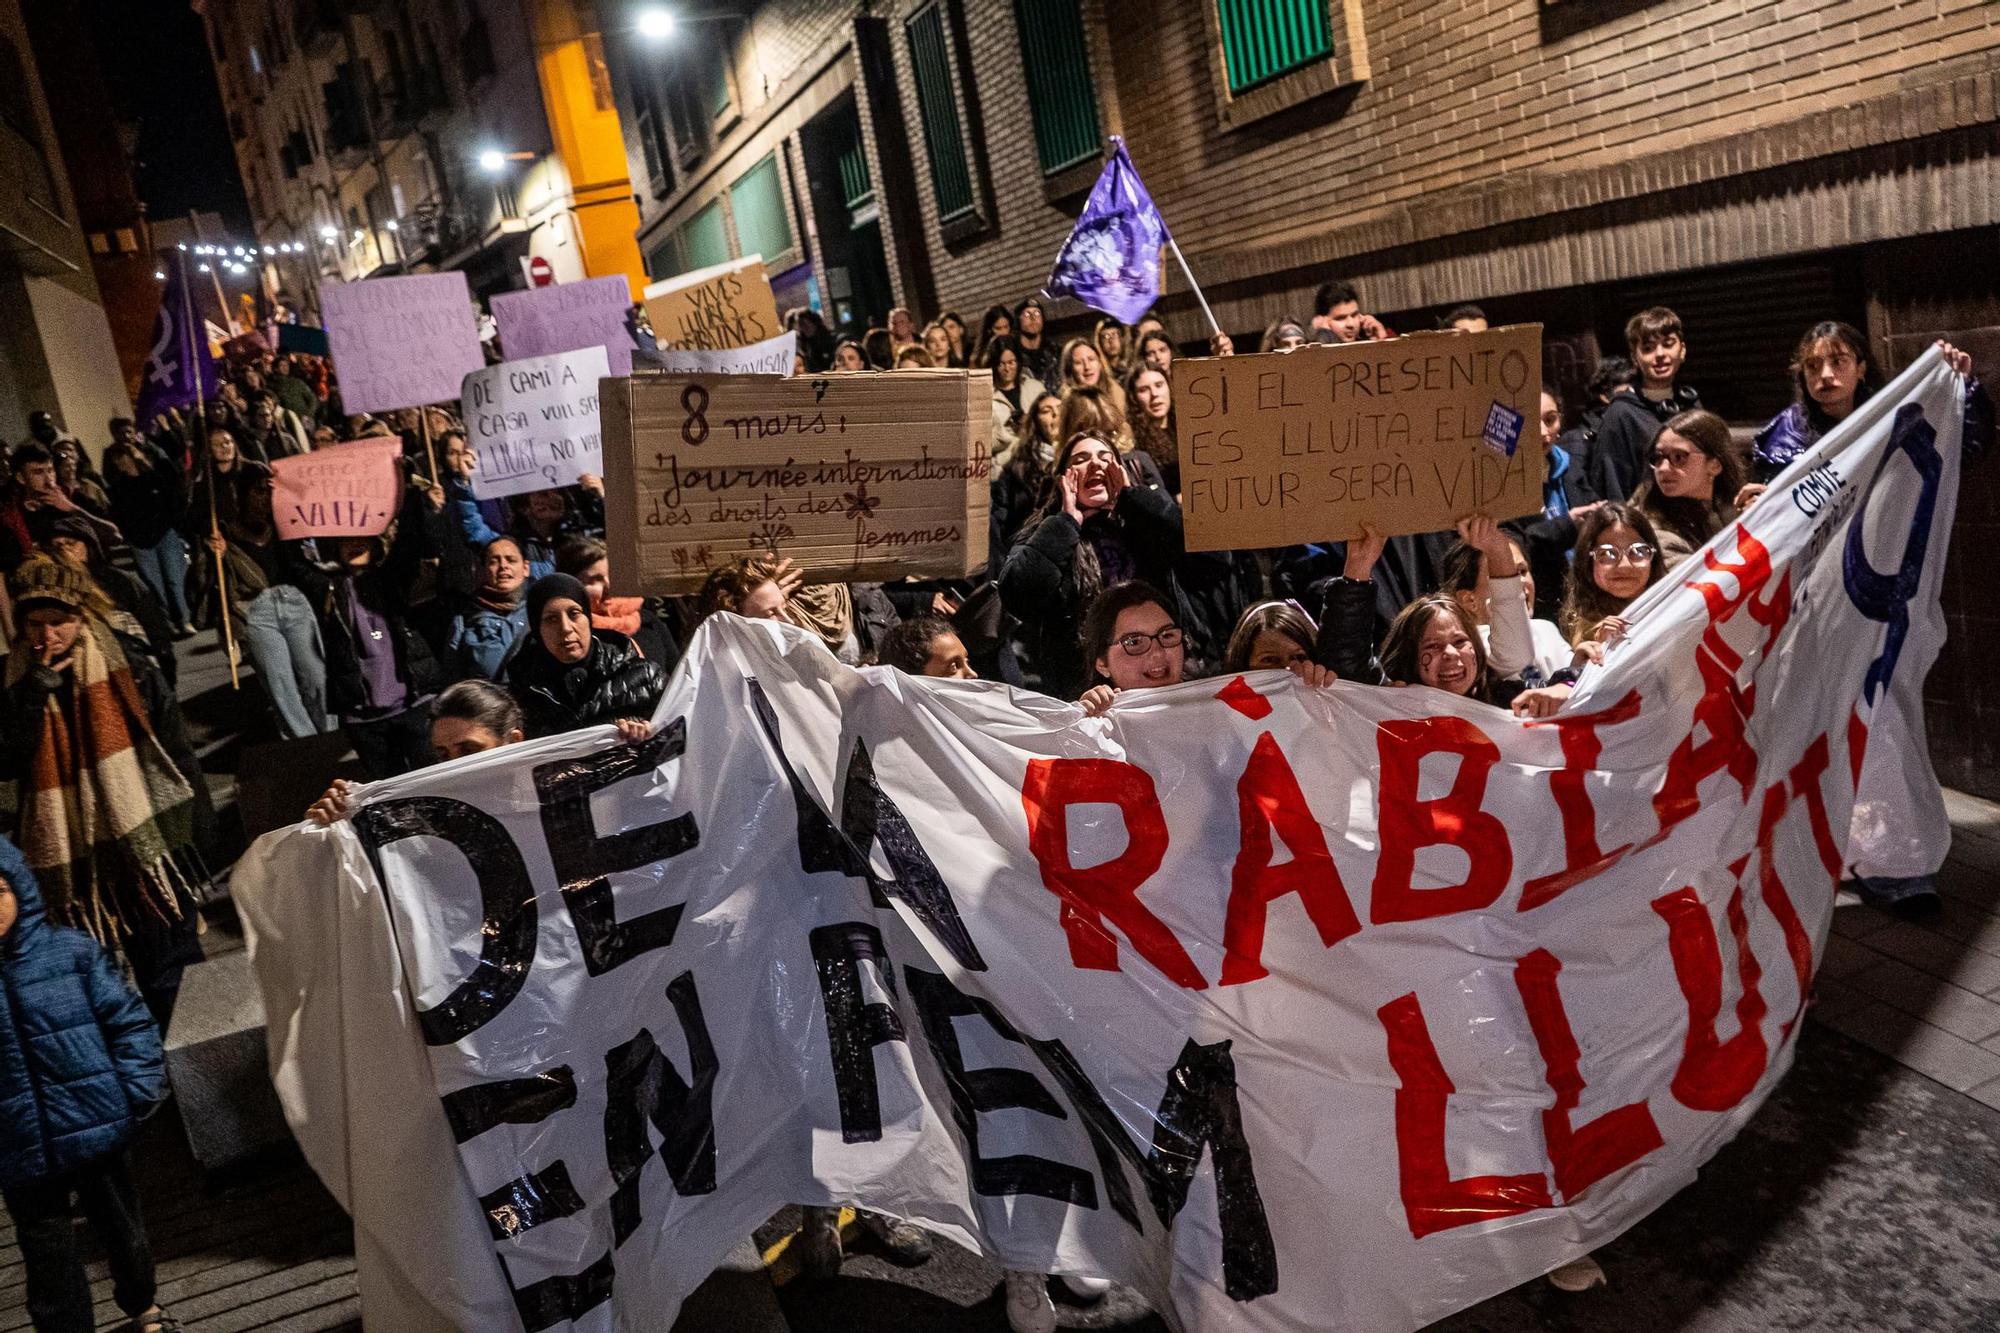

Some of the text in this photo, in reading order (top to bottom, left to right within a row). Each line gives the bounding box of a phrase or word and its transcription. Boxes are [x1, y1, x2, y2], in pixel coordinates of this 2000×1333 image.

[473, 379, 494, 408] DE
[562, 365, 577, 385] A
[681, 384, 710, 446] 8
[1257, 371, 1304, 411] EL
[478, 411, 529, 437] CASA
[550, 438, 576, 460] NO
[1191, 429, 1244, 467] ES
[1434, 406, 1485, 443] EL
[655, 452, 808, 508] Journée
[1190, 445, 1527, 514] FUTUR SERÀ VIDA
[646, 490, 847, 527] des droits des
[853, 514, 961, 572] femmes
[354, 714, 702, 1048] DE
[1376, 702, 1870, 1240] LLUIT
